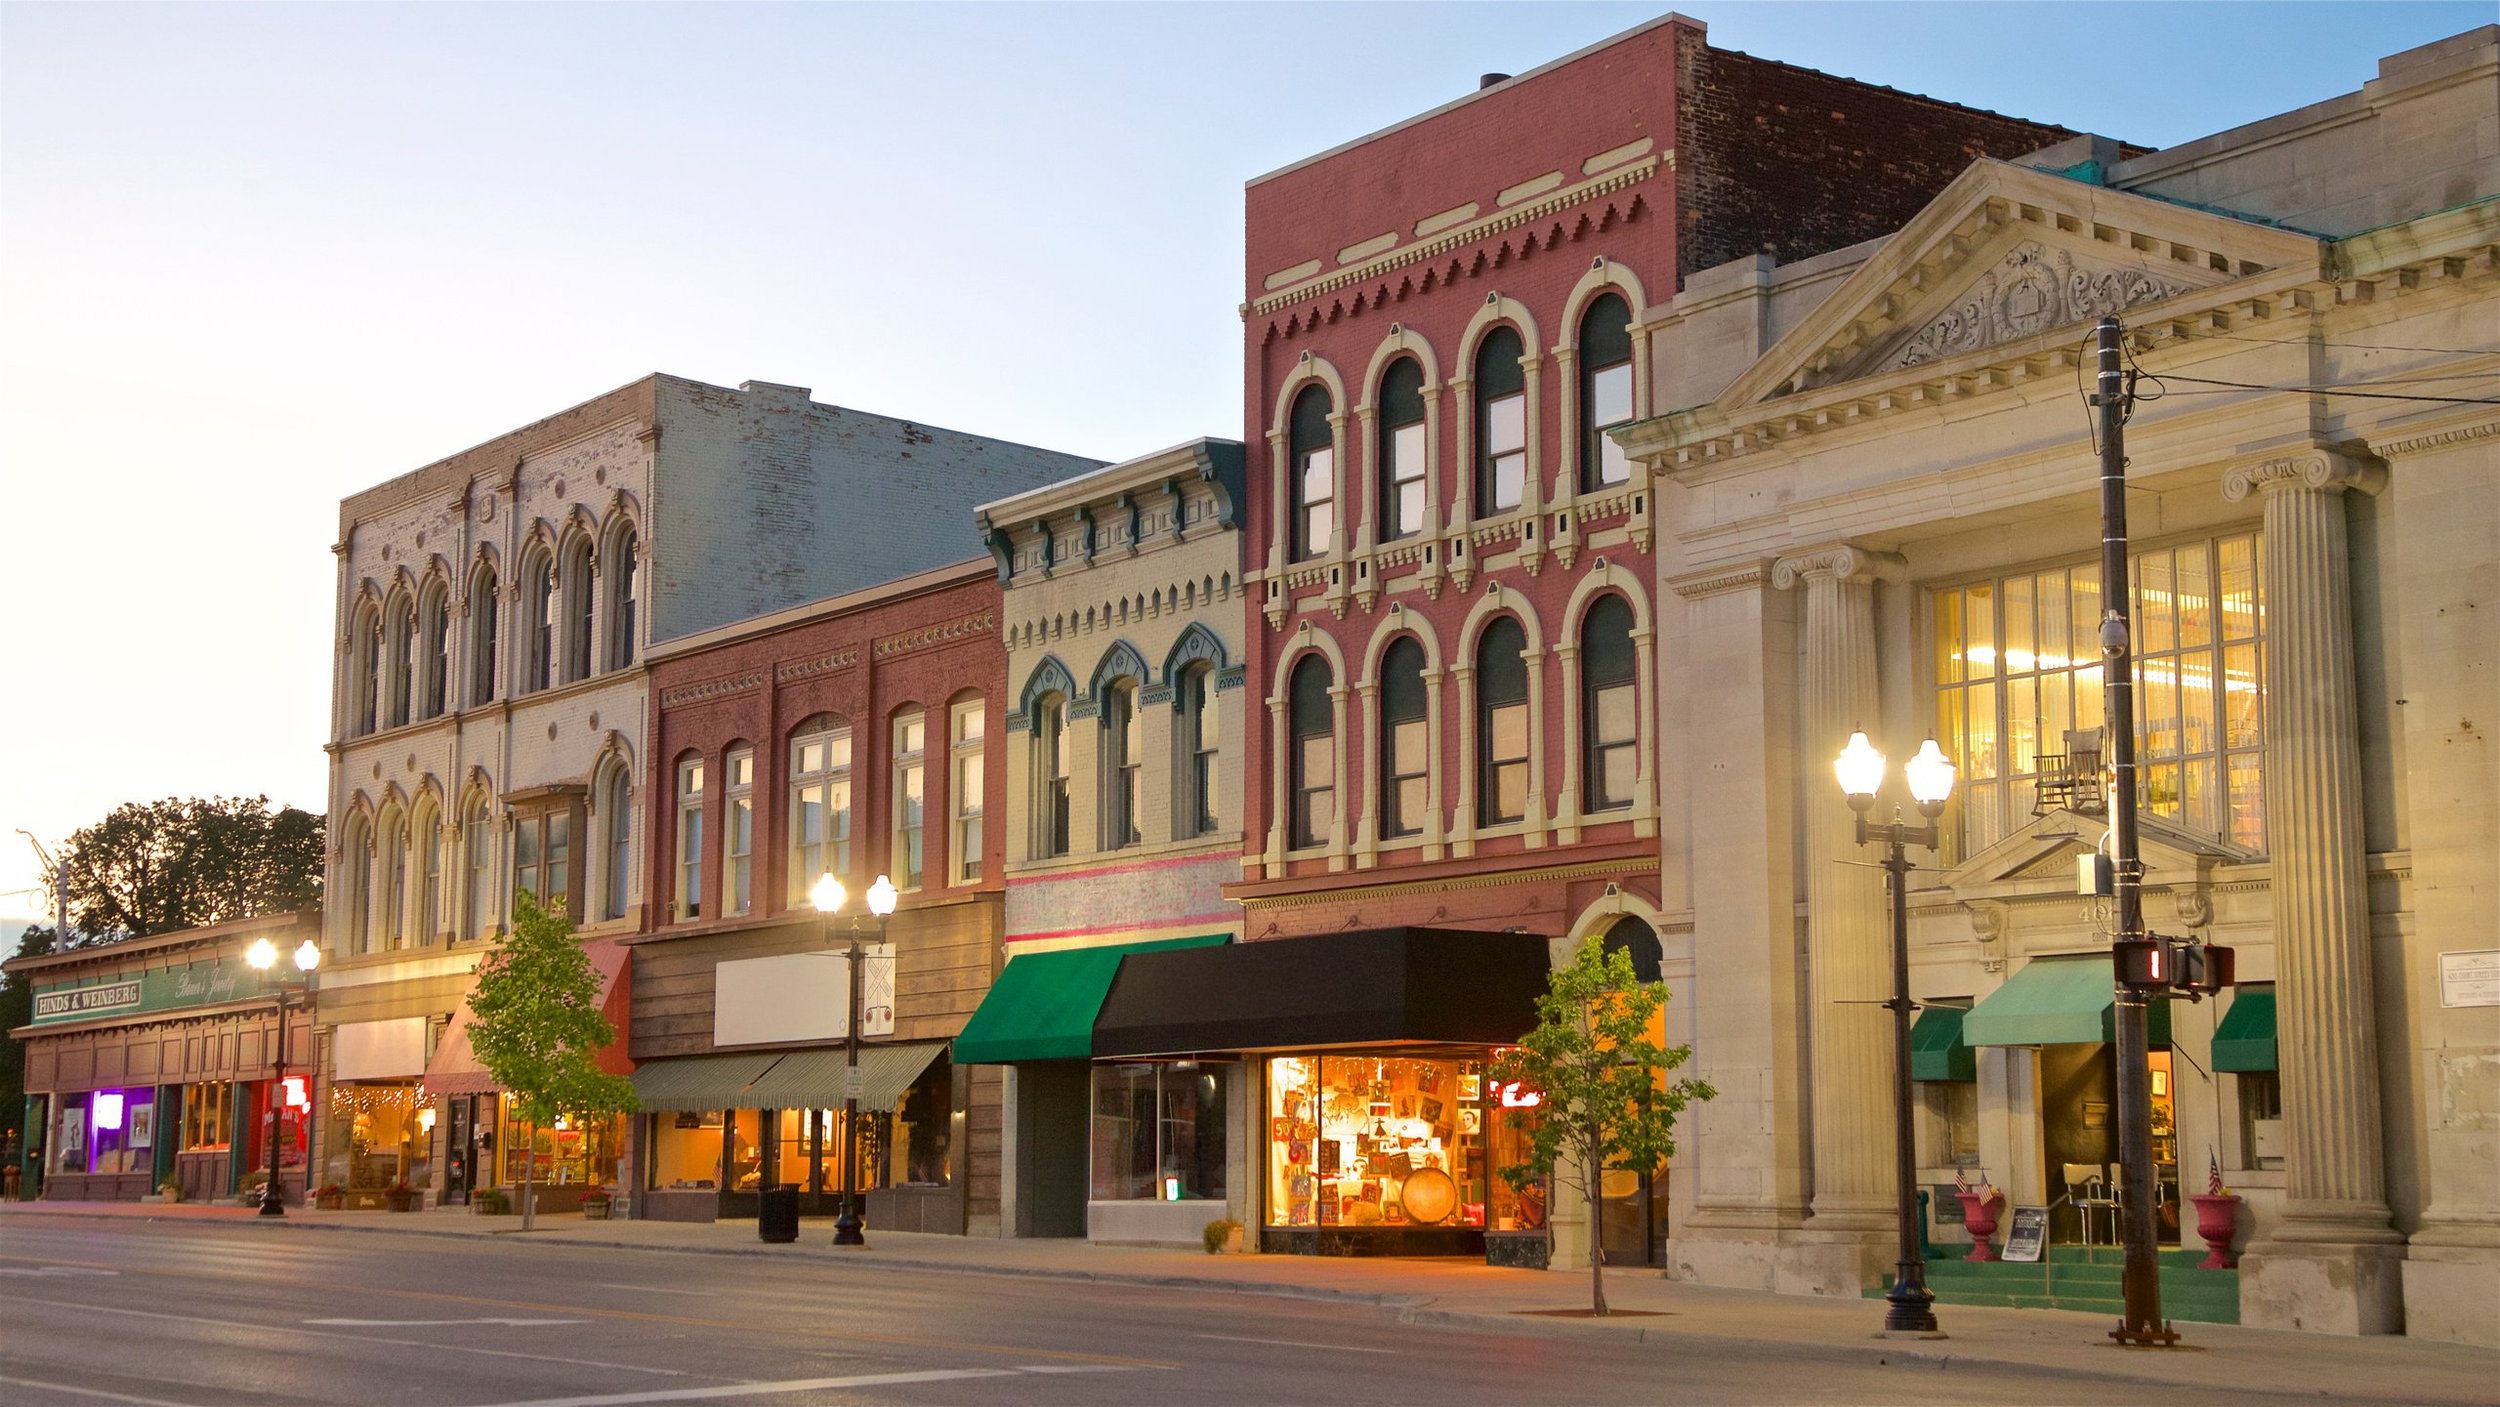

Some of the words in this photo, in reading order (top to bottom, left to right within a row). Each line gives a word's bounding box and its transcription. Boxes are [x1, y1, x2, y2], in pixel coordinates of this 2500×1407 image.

[39, 996, 70, 1014] HINDS
[71, 994, 80, 1009] &
[82, 986, 137, 1008] WEINBERG
